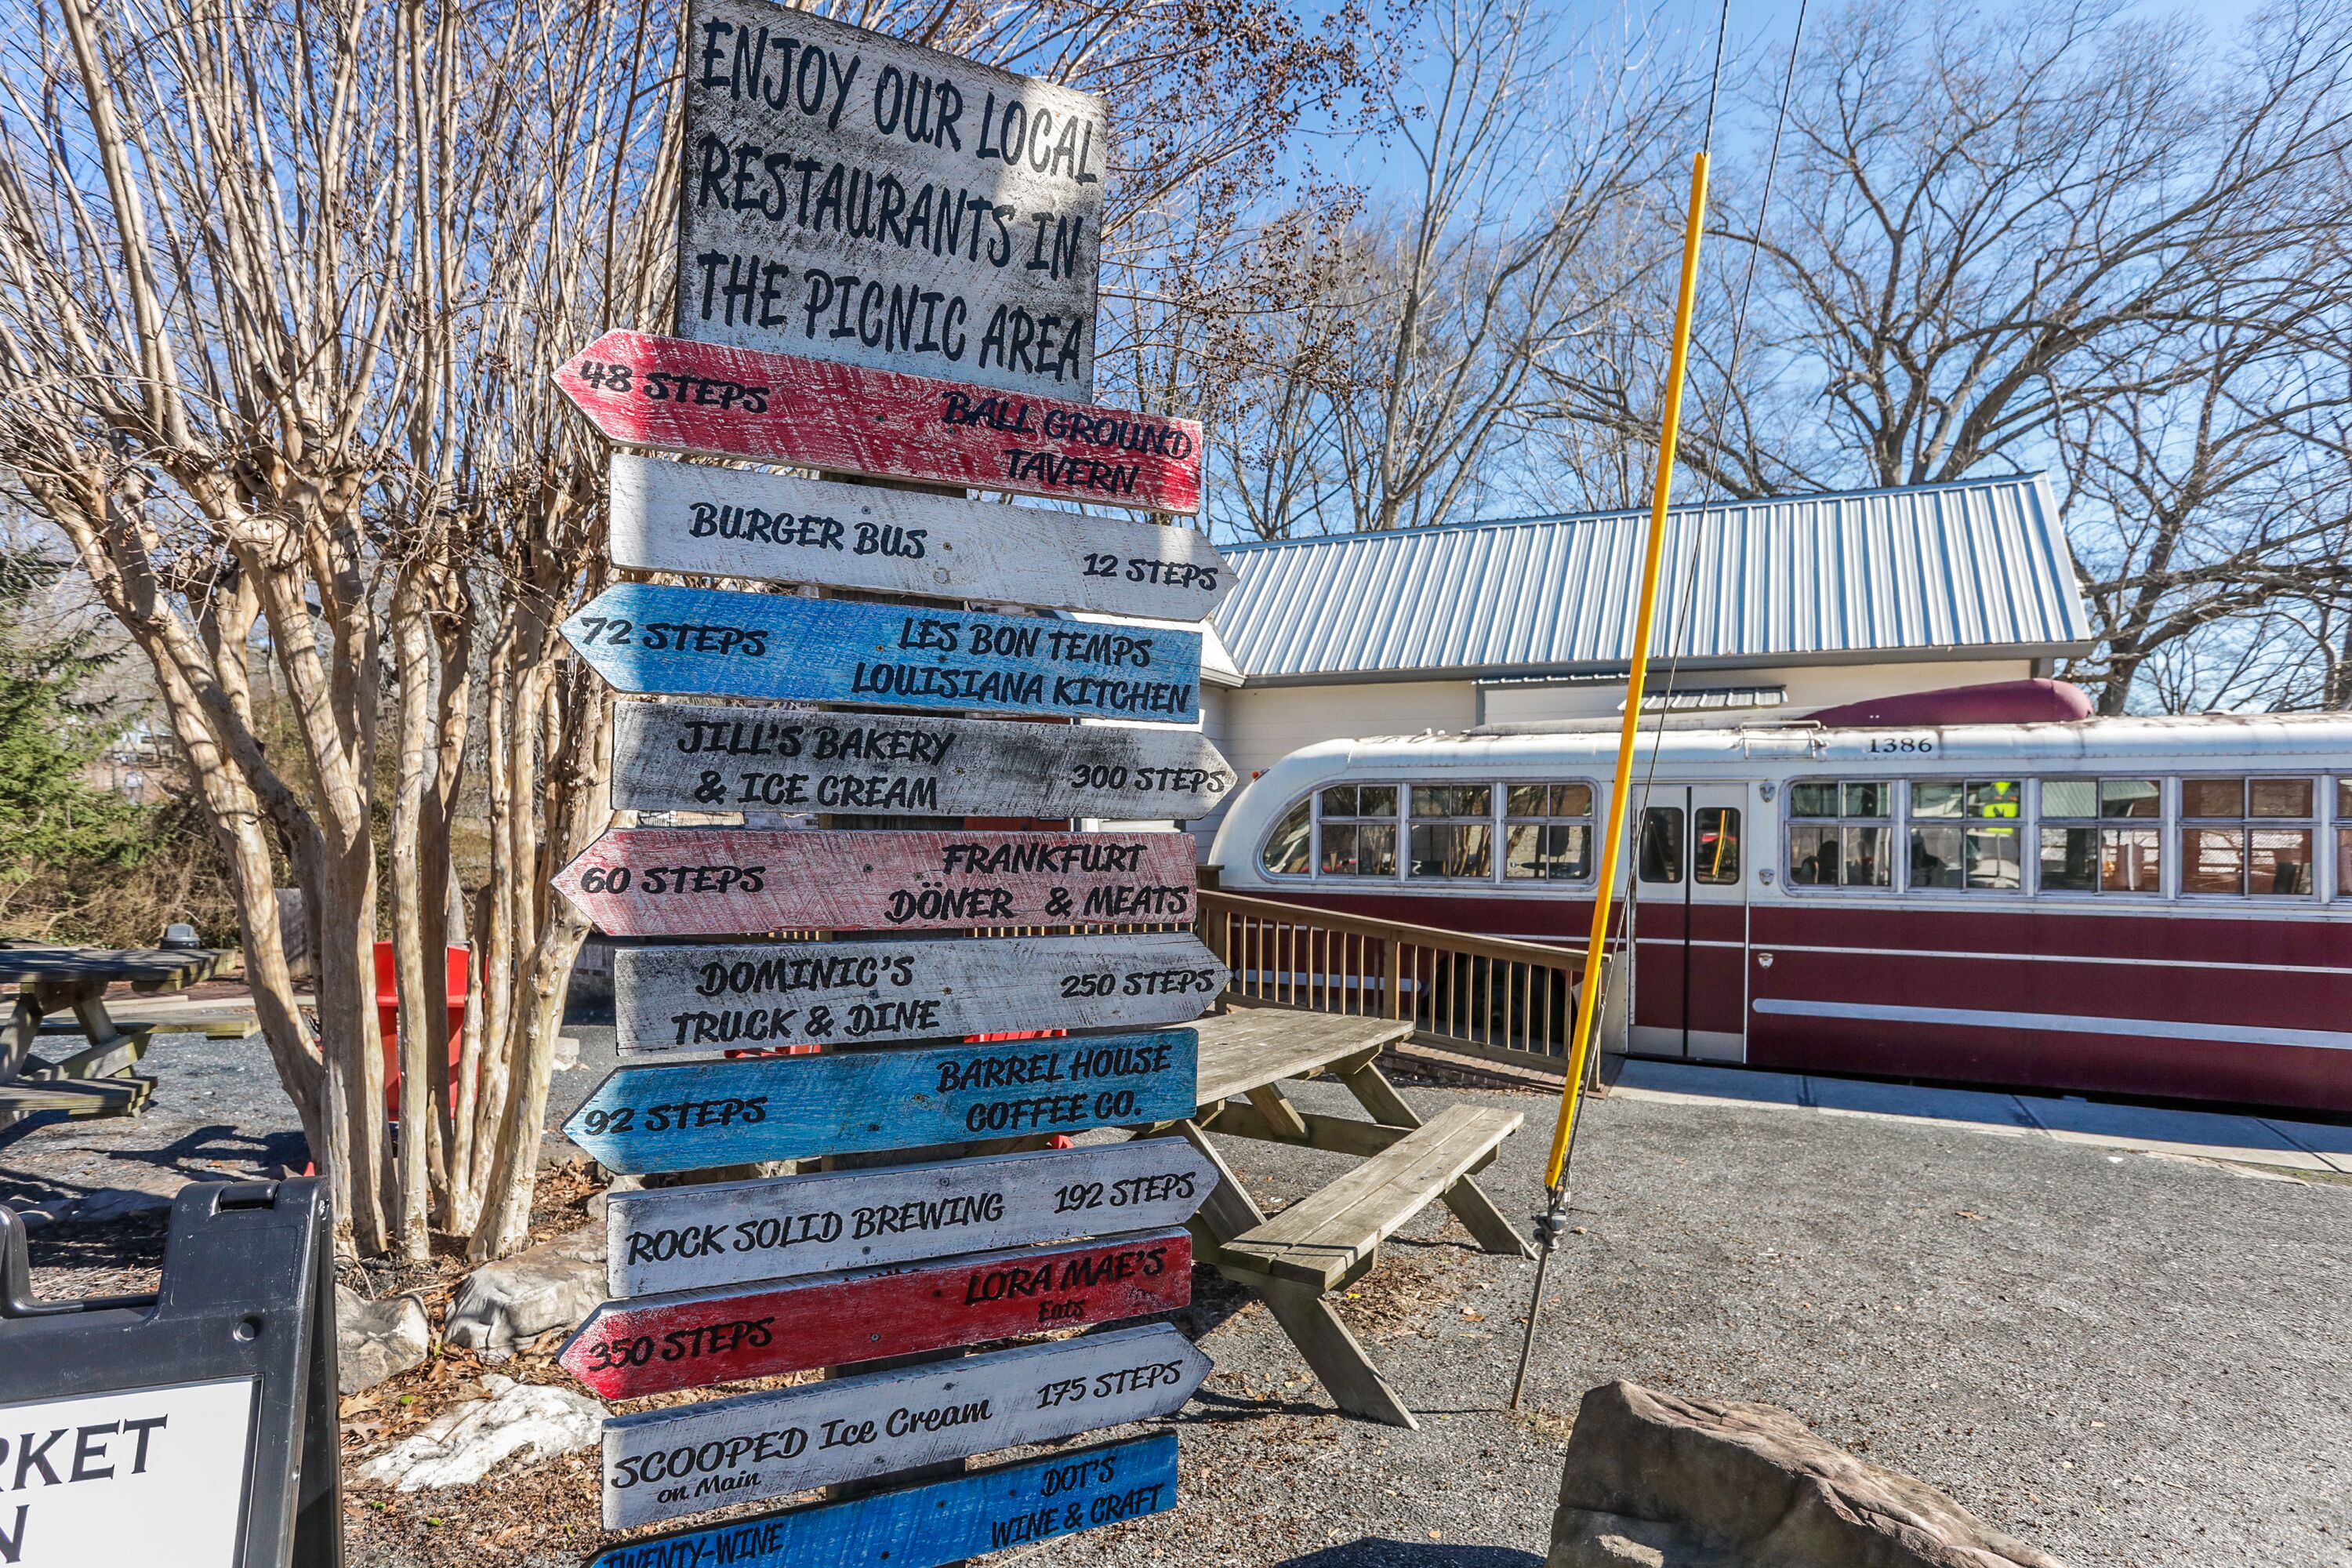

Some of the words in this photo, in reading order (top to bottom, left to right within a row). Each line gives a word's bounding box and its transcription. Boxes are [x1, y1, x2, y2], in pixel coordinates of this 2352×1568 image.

[703, 16, 861, 131] ENJOY
[874, 64, 964, 151] OUR
[976, 92, 1098, 186] LOCAL
[698, 132, 1016, 267] RESTAURANTS
[1026, 212, 1083, 281] IN
[697, 249, 789, 328] THE
[804, 268, 967, 361] PICNIC
[978, 303, 1083, 382] AREA
[579, 361, 633, 392] 48
[643, 372, 770, 414] STEPS
[942, 391, 1035, 434] BALL
[1044, 409, 1192, 460] GROUND
[1005, 448, 1140, 494] TAVERN
[688, 502, 845, 552] BURGER
[853, 522, 927, 559] BUS
[1083, 553, 1117, 577] 12
[1126, 558, 1218, 591] STEPS
[580, 617, 633, 645] 72
[642, 622, 768, 657] STEPS
[898, 617, 960, 652] LES
[969, 624, 1042, 660] BON
[1048, 630, 1153, 668] TEMPS
[851, 662, 1044, 705] LOUISIANA
[1053, 676, 1191, 713] KITCHEN
[677, 720, 804, 757] JILL'S
[813, 727, 956, 766] BAKERY
[1869, 737, 1933, 753] 1386
[694, 770, 727, 805] &
[737, 771, 809, 806] ICE
[817, 774, 938, 811] CREAM
[1072, 764, 1126, 790] 300
[1134, 767, 1226, 793] STEPS
[580, 866, 631, 894] 60
[641, 866, 766, 894] STEPS
[942, 842, 1148, 875] FRANKFURT
[884, 882, 1014, 924] DÖNER
[1044, 887, 1073, 916] &
[1083, 885, 1189, 916] MEATS
[695, 956, 915, 997] DOMINIC'S
[1060, 973, 1116, 999] 250
[1122, 969, 1216, 996] STEPS
[670, 1007, 797, 1046] TRUCK
[804, 1005, 834, 1037] &
[843, 999, 942, 1036] DINE
[936, 1053, 1065, 1093] BARREL
[1069, 1044, 1172, 1080] HOUSE
[584, 1108, 633, 1135] 92
[644, 1096, 768, 1132] STEPS
[965, 1093, 1088, 1132] COFFEE
[1094, 1090, 1142, 1120] CO.
[1054, 1181, 1105, 1214] 192
[1109, 1171, 1196, 1207] STEPS
[626, 1225, 728, 1266] ROCK
[732, 1210, 843, 1252] SOLID
[851, 1192, 1005, 1240] BREWING
[964, 1267, 1051, 1306] LORA
[1059, 1247, 1168, 1290] MAE'S
[1038, 1298, 1085, 1323] Eats
[589, 1334, 655, 1372] 350
[662, 1316, 775, 1361] STEPS
[1036, 1377, 1087, 1409] 175
[1094, 1359, 1183, 1398] STEPS
[611, 1427, 809, 1489] SCOOPED
[818, 1417, 878, 1450] Ice
[885, 1399, 993, 1438] Cream
[657, 1486, 689, 1504] on
[695, 1469, 761, 1498] Main
[1040, 1455, 1117, 1497] DOT'S
[991, 1506, 1059, 1548] WINE
[1063, 1501, 1083, 1529] &
[1090, 1483, 1165, 1525] CRAFT
